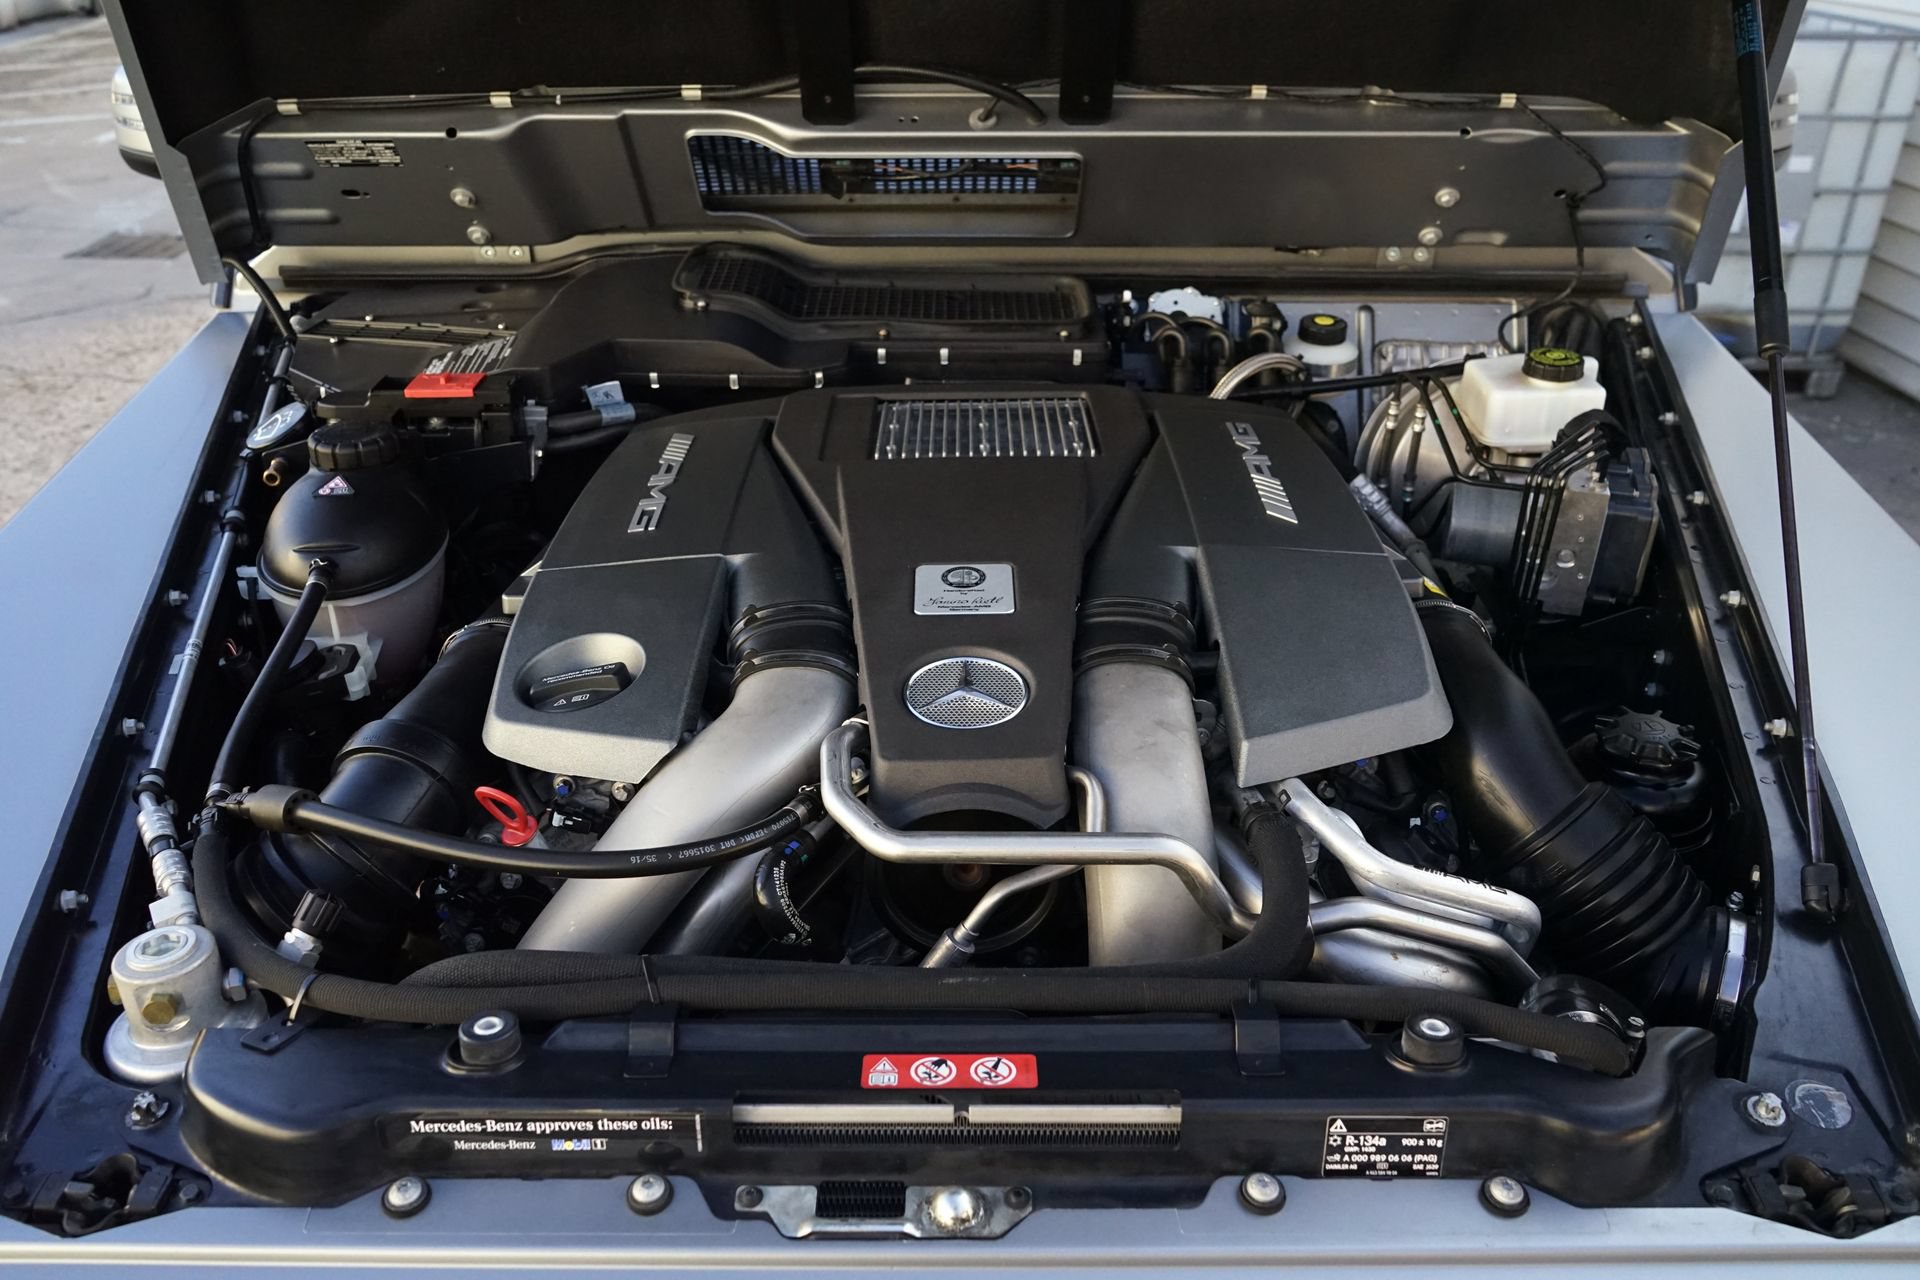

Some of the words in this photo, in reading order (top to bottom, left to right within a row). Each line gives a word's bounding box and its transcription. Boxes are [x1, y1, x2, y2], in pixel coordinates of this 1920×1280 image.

[678, 844, 716, 859] 3015667
[630, 854, 657, 864] 35/16
[410, 1120, 523, 1133] Mercedes-Benz
[526, 1120, 594, 1135] approves
[597, 1118, 638, 1131] these
[641, 1117, 673, 1131] oils:
[453, 1140, 536, 1150] Mercedes-Benz
[551, 1138, 592, 1151] Mobil
[1345, 1135, 1387, 1147] R-134a
[1401, 1138, 1417, 1146] 900
[1342, 1154, 1350, 1162] A
[1351, 1154, 1368, 1162] 000
[1369, 1154, 1387, 1162] 989
[1388, 1154, 1400, 1162] 06
[1401, 1154, 1413, 1162] 06
[1414, 1154, 1438, 1163] (PAG)
